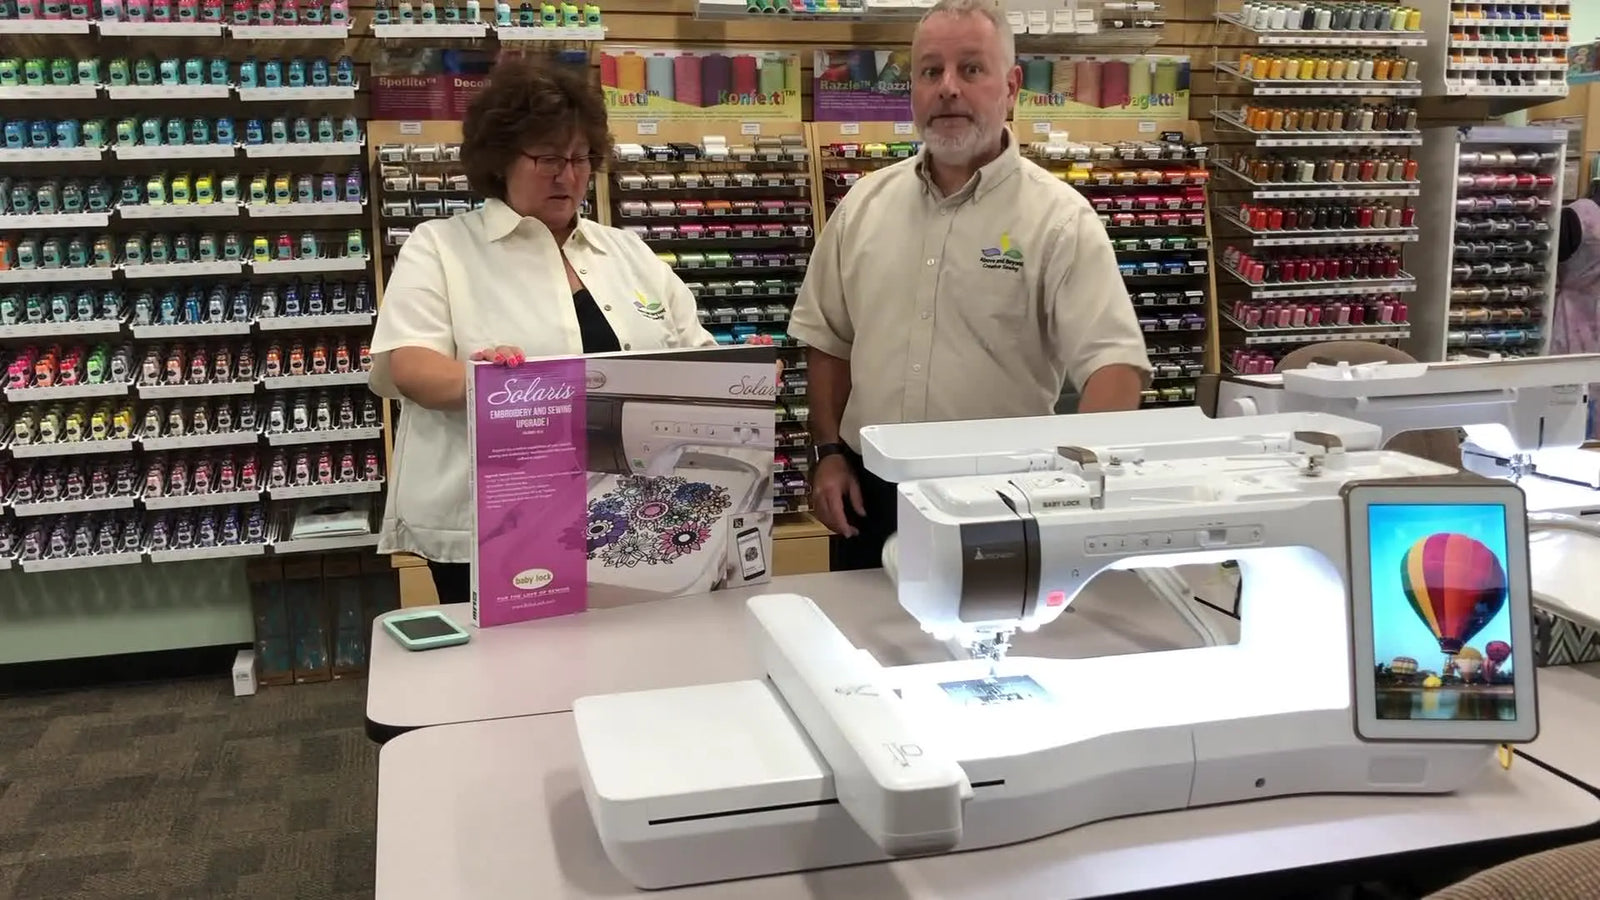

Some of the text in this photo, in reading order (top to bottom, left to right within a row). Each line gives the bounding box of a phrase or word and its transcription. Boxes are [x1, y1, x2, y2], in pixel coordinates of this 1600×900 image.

[490, 405, 572, 419] EMBROIDERY AND SEWING
[516, 418, 545, 428] UPGRADE
[515, 573, 552, 586] baby lock
